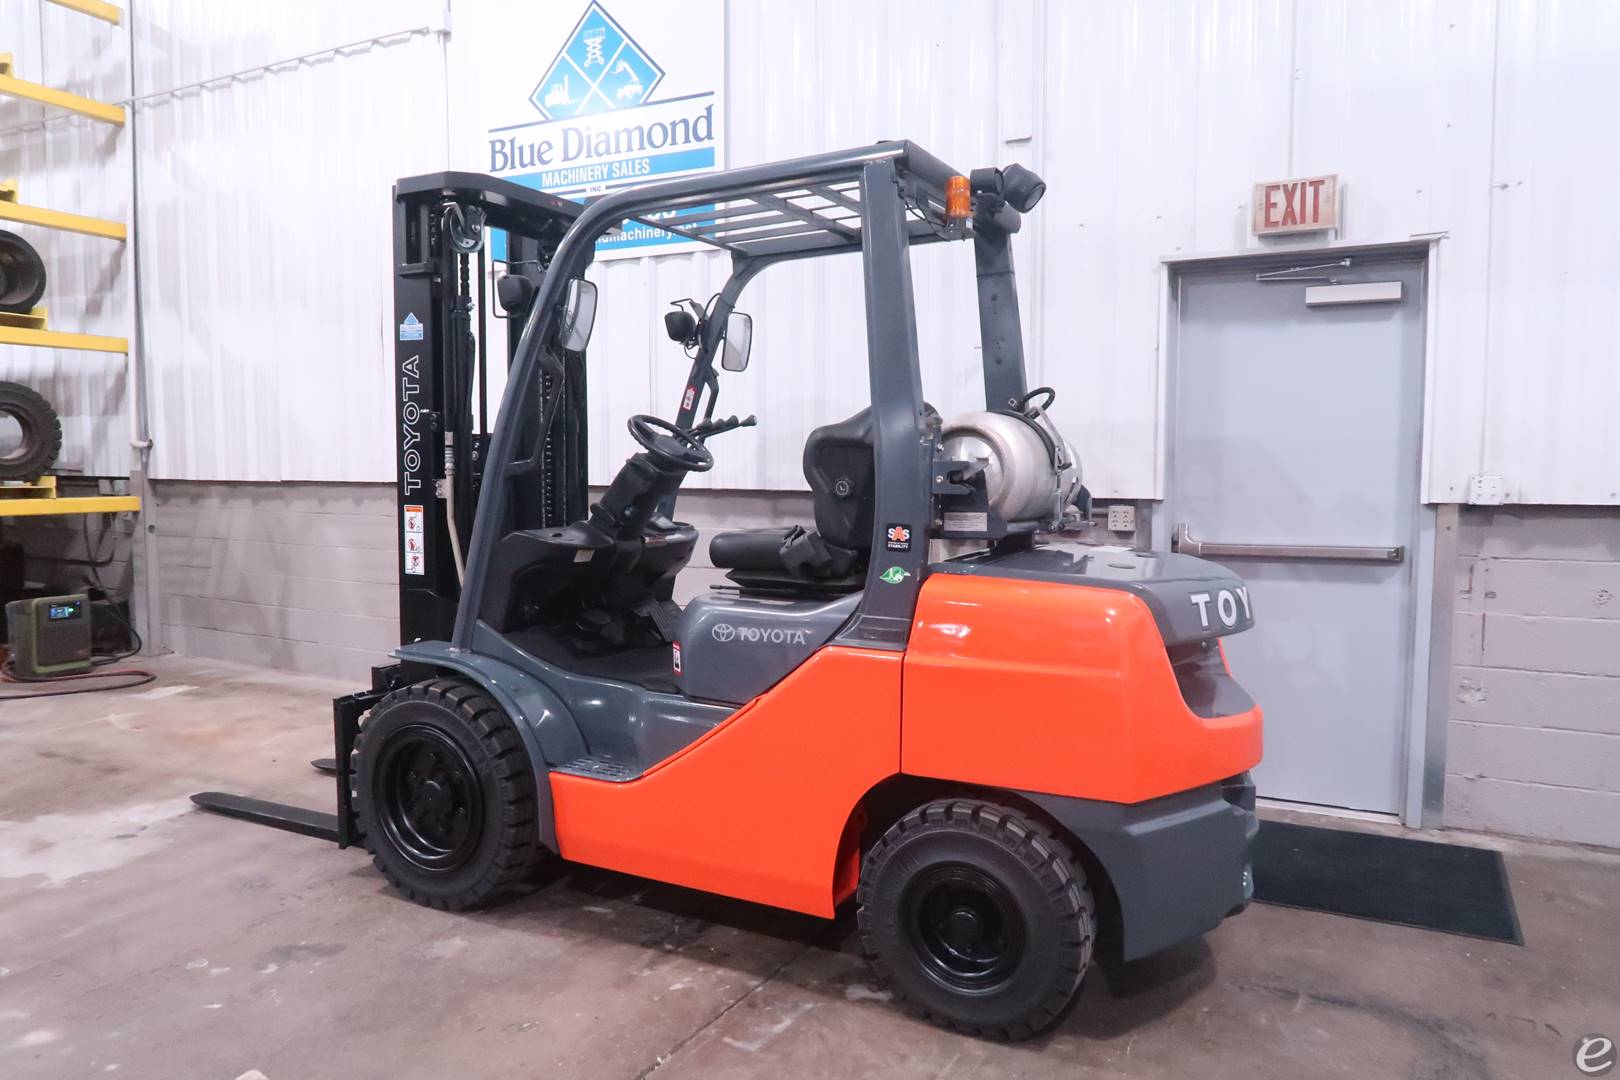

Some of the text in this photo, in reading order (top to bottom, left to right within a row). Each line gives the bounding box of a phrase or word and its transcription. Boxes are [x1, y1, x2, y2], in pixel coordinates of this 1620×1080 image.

[489, 103, 715, 173] Blue Diamond
[541, 158, 650, 188] MACHINERY SALES
[1264, 180, 1326, 228] EXIT
[402, 355, 421, 496] TOYOTA
[887, 526, 910, 541] SAS
[1190, 586, 1251, 627] TOY
[737, 626, 806, 645] TOYOTA
